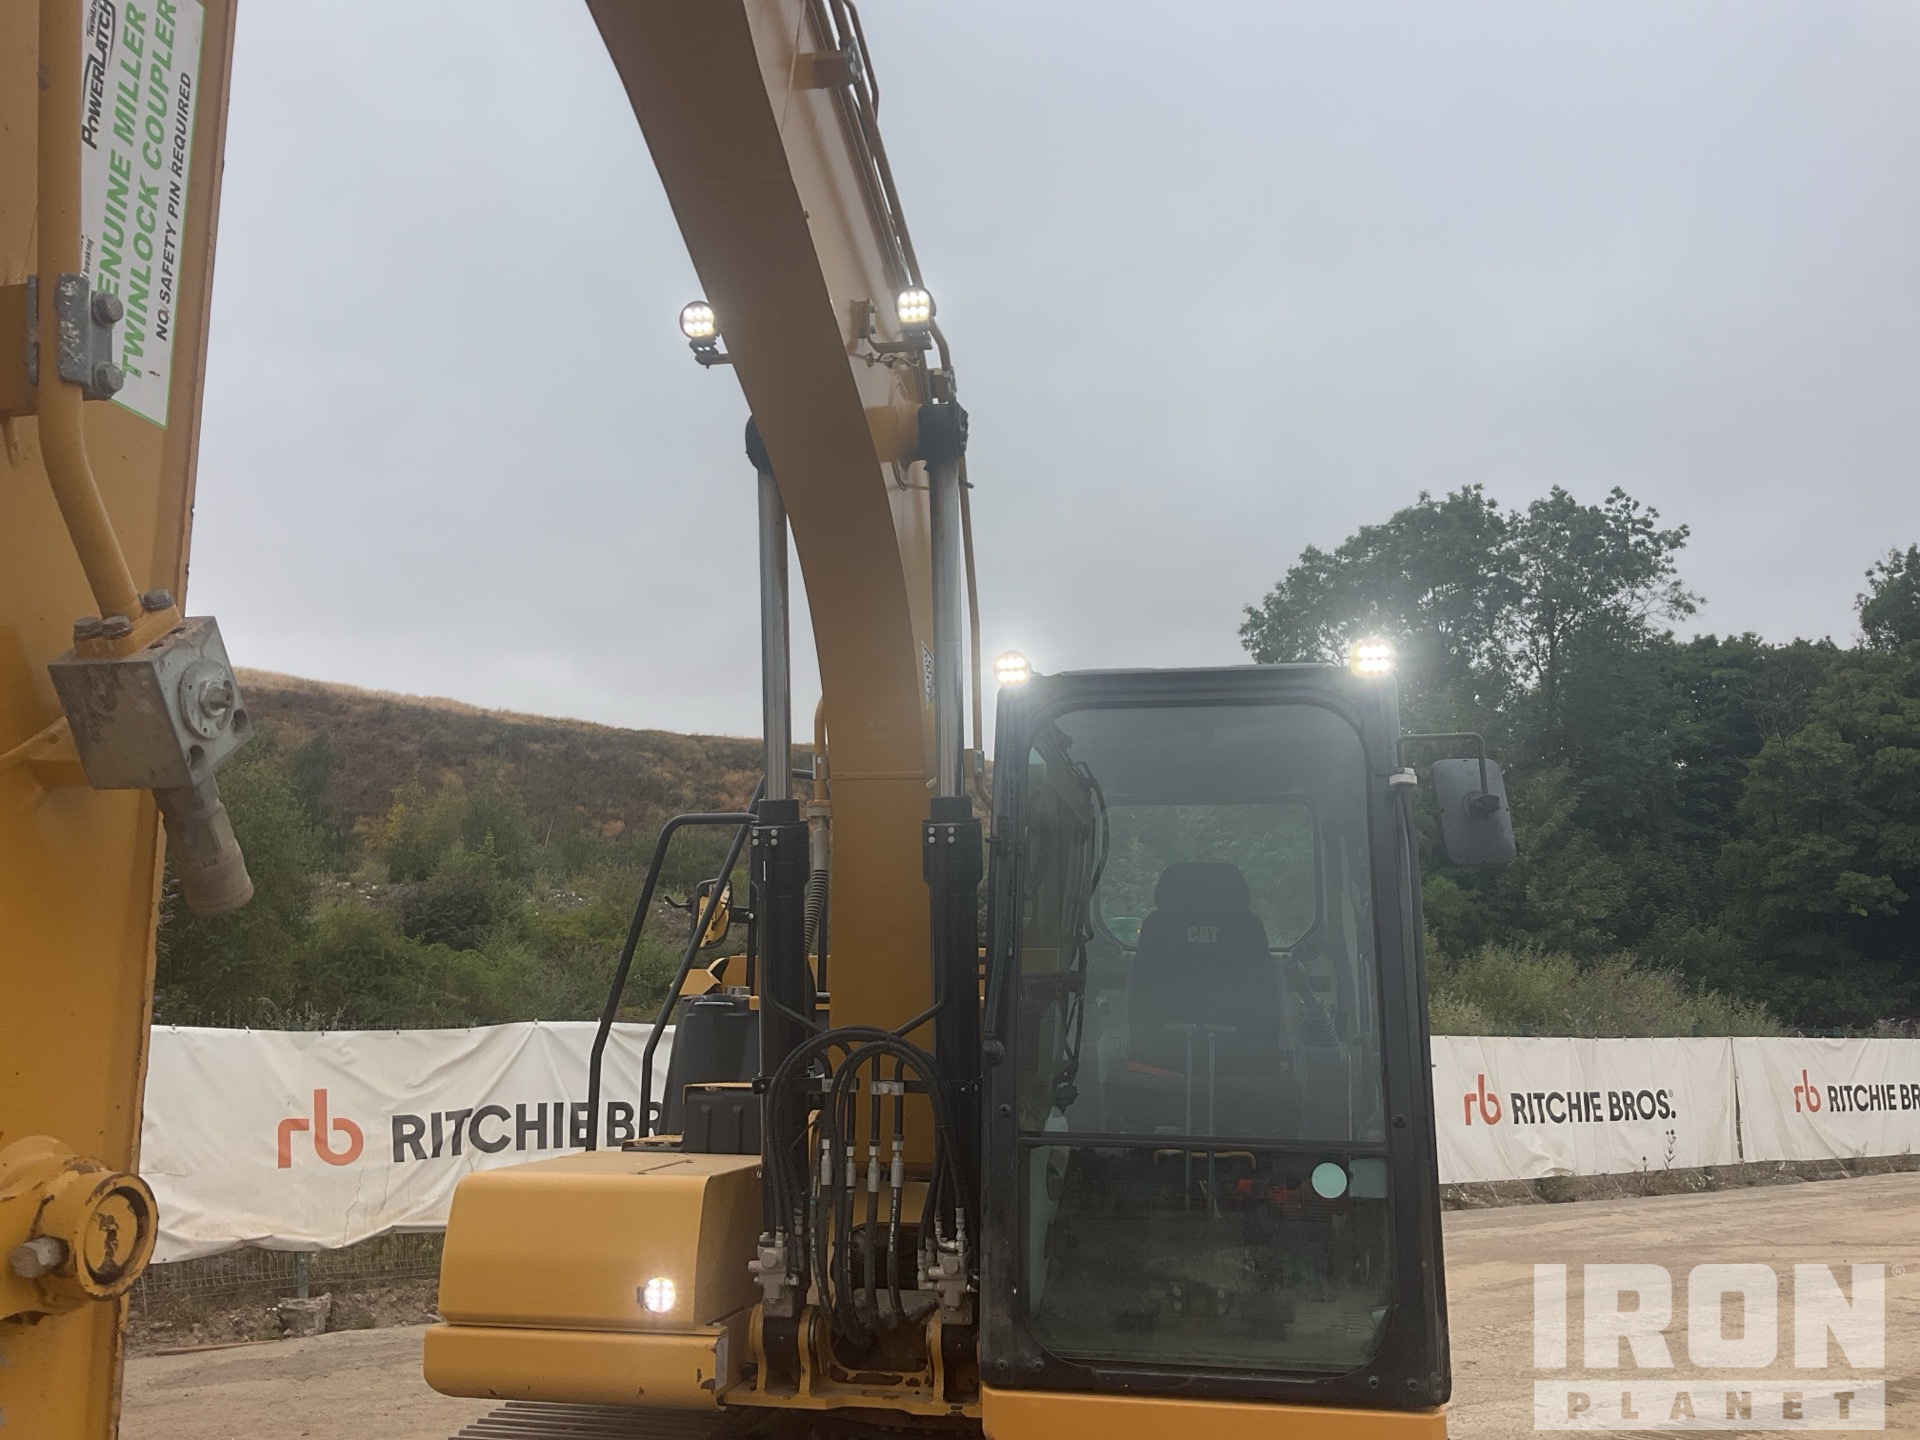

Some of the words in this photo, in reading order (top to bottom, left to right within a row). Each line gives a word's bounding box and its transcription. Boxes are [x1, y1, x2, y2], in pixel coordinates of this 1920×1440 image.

[112, 2, 146, 147] MILLER
[171, 72, 191, 178] REQUIRED
[121, 175, 159, 378] TWINLOCK
[142, 0, 176, 171] COUPLER
[168, 181, 181, 219] PIN
[83, 238, 94, 274] breaking
[97, 149, 131, 300] ENUINE
[159, 220, 177, 304] SAFETY
[156, 308, 171, 341] NO
[1187, 926, 1219, 943] CAT
[1463, 1073, 1501, 1126] rb
[1510, 1091, 1604, 1125] RITCHIE
[1793, 1069, 1822, 1113] rb
[1826, 1084, 1897, 1112] RITCHIE
[277, 1088, 364, 1168] rb
[391, 1101, 589, 1163] RITCHIE
